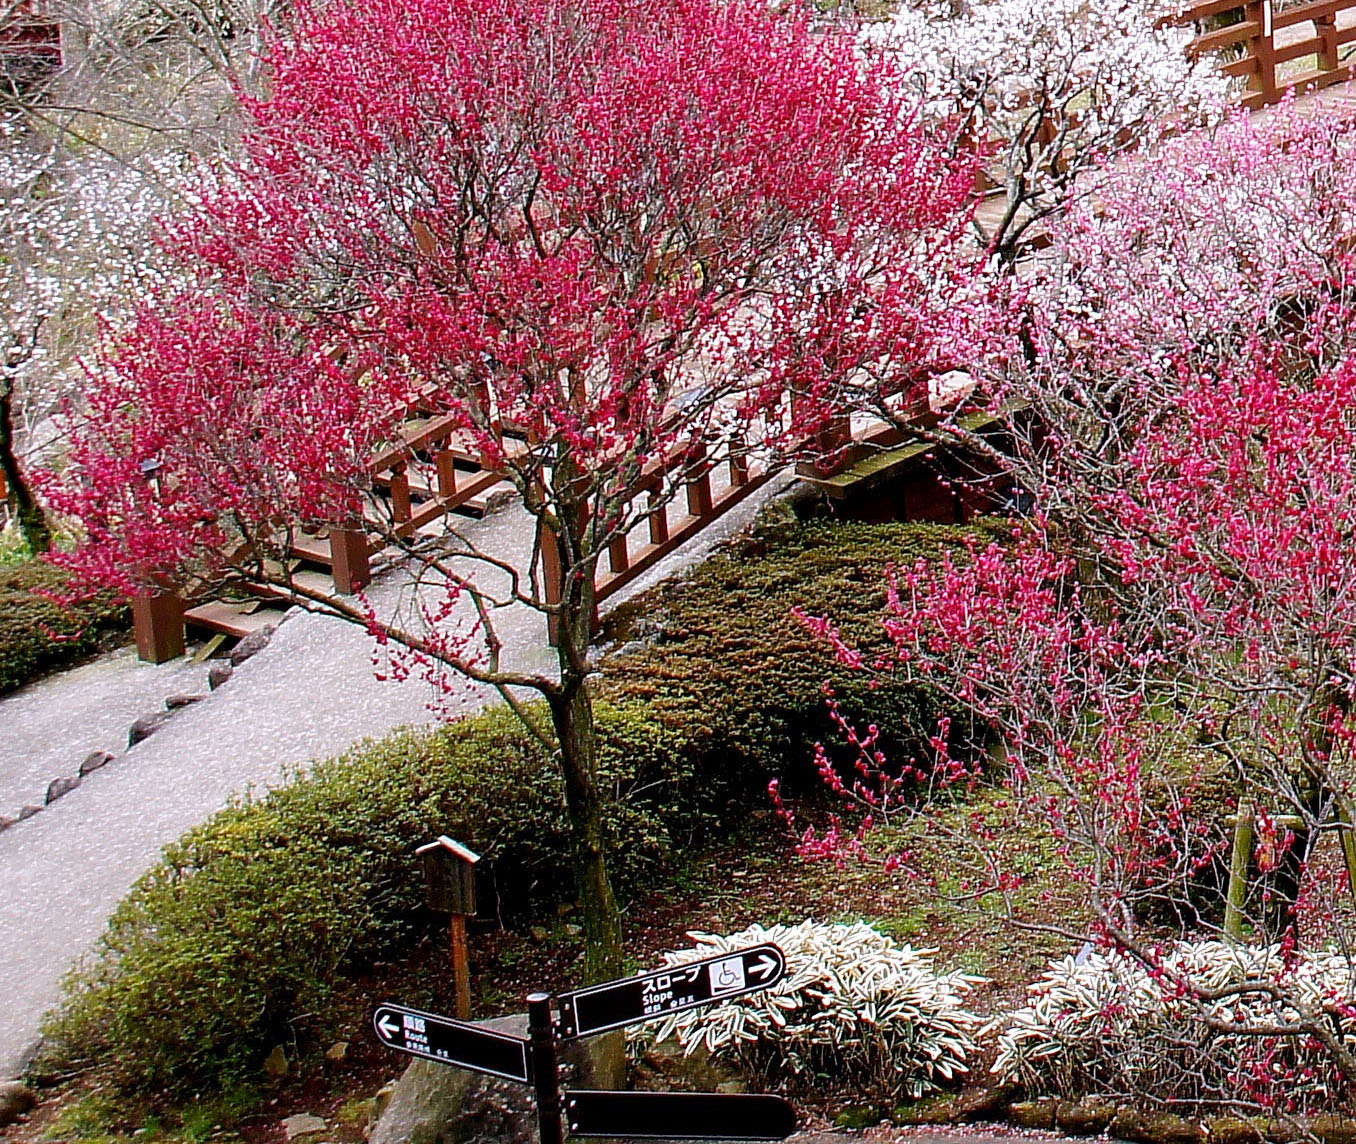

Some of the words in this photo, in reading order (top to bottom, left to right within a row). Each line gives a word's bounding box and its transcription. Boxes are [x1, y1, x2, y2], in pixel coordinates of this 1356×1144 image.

[642, 965, 701, 994] スロープ
[642, 991, 673, 1006] Slope
